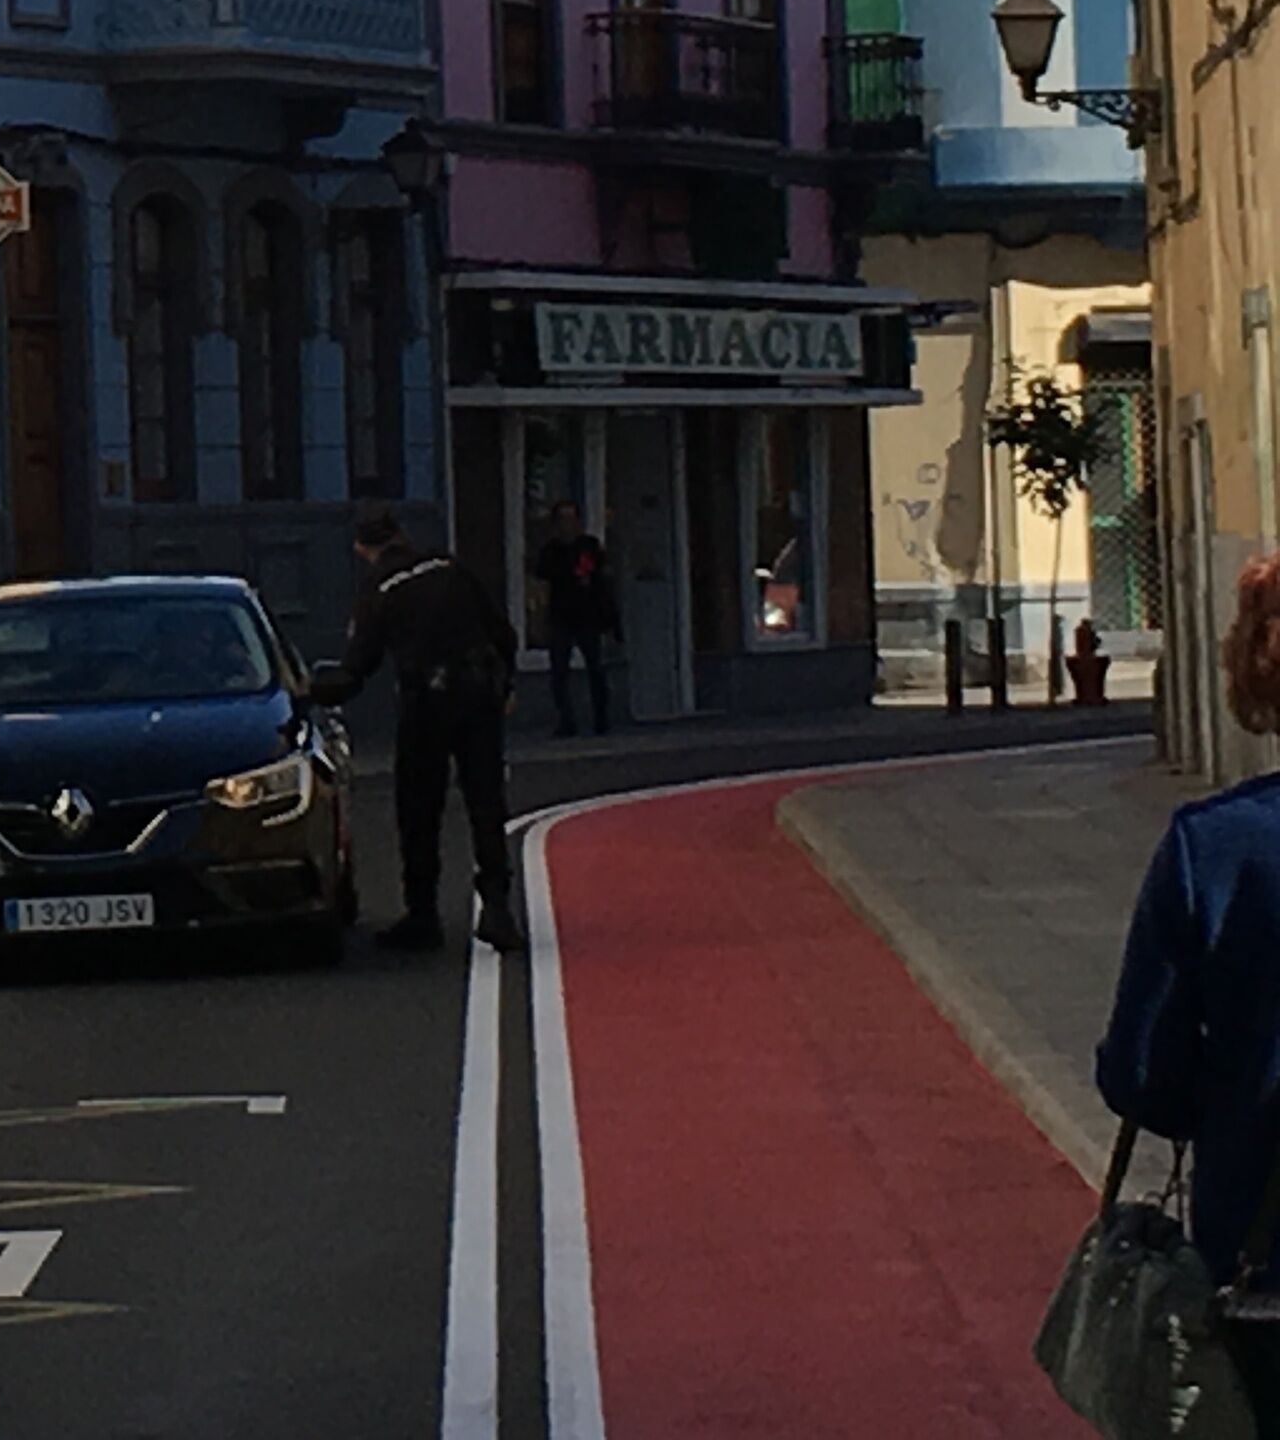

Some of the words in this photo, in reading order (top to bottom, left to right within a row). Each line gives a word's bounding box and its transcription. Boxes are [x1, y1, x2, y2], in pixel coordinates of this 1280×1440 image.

[546, 311, 858, 369] FARMACIA
[24, 901, 90, 926] 1320
[99, 898, 147, 923] JSV
